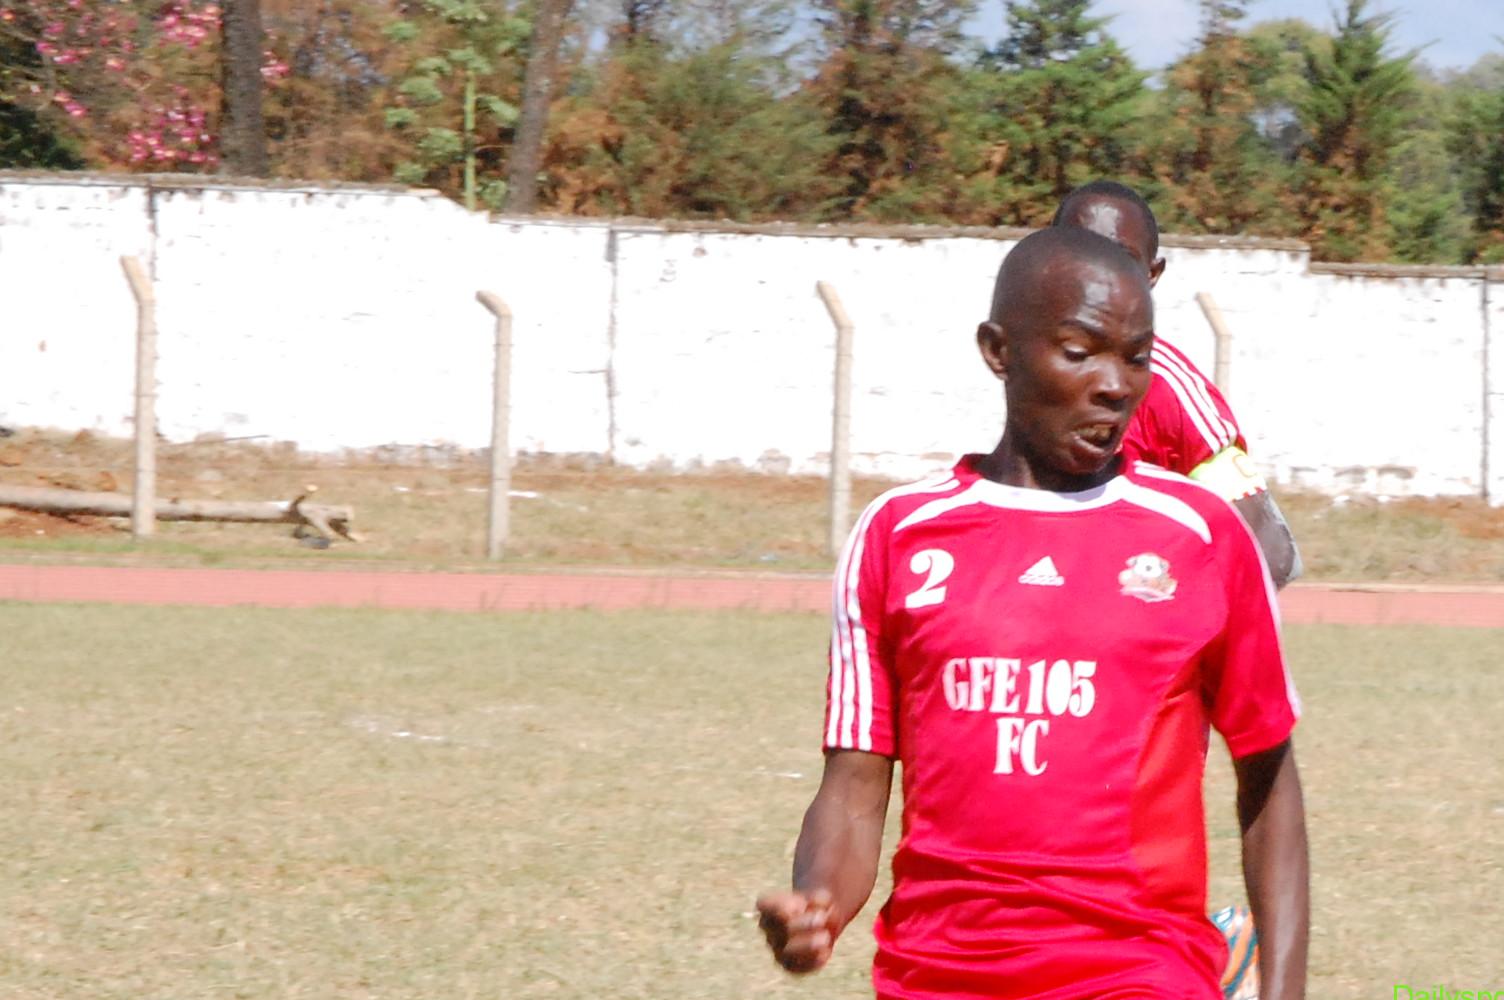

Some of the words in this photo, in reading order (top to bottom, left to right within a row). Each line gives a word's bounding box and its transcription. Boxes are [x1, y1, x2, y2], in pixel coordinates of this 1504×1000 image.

[905, 548, 955, 608] 2
[942, 657, 1020, 714] GFE
[1027, 660, 1097, 718] 105
[993, 717, 1049, 776] FC
